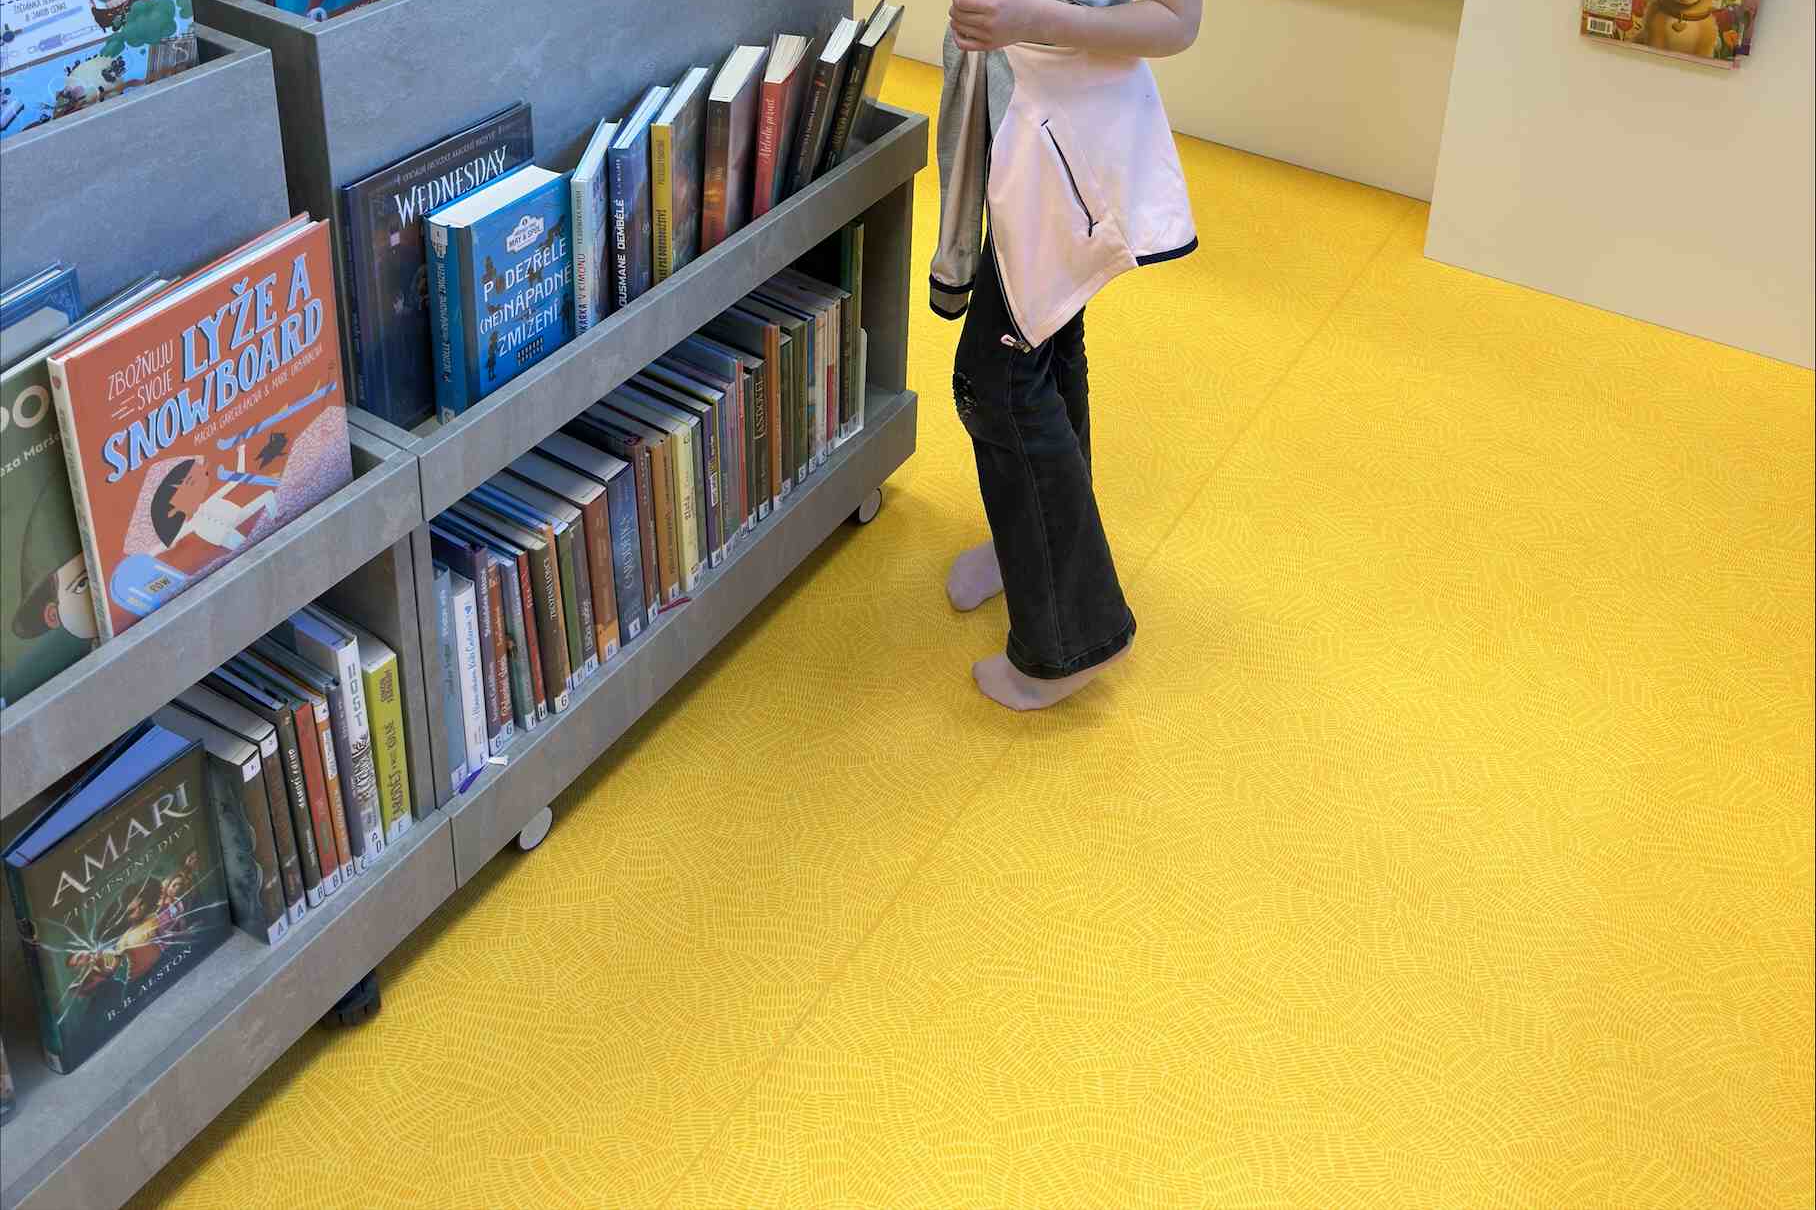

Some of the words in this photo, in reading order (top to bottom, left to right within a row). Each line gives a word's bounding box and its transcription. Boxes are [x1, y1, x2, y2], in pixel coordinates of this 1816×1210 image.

[394, 144, 507, 230] WEDNESDAY
[483, 236, 568, 303] PDEZŘELÉ
[181, 270, 279, 382] LYŽE
[286, 252, 313, 312] A
[102, 298, 325, 484] SNOWBOARD
[107, 339, 174, 402] ZBOŽŇUJU
[137, 368, 173, 412] SVOJE
[50, 779, 199, 908] AMARI
[138, 946, 194, 996] ALSTON
